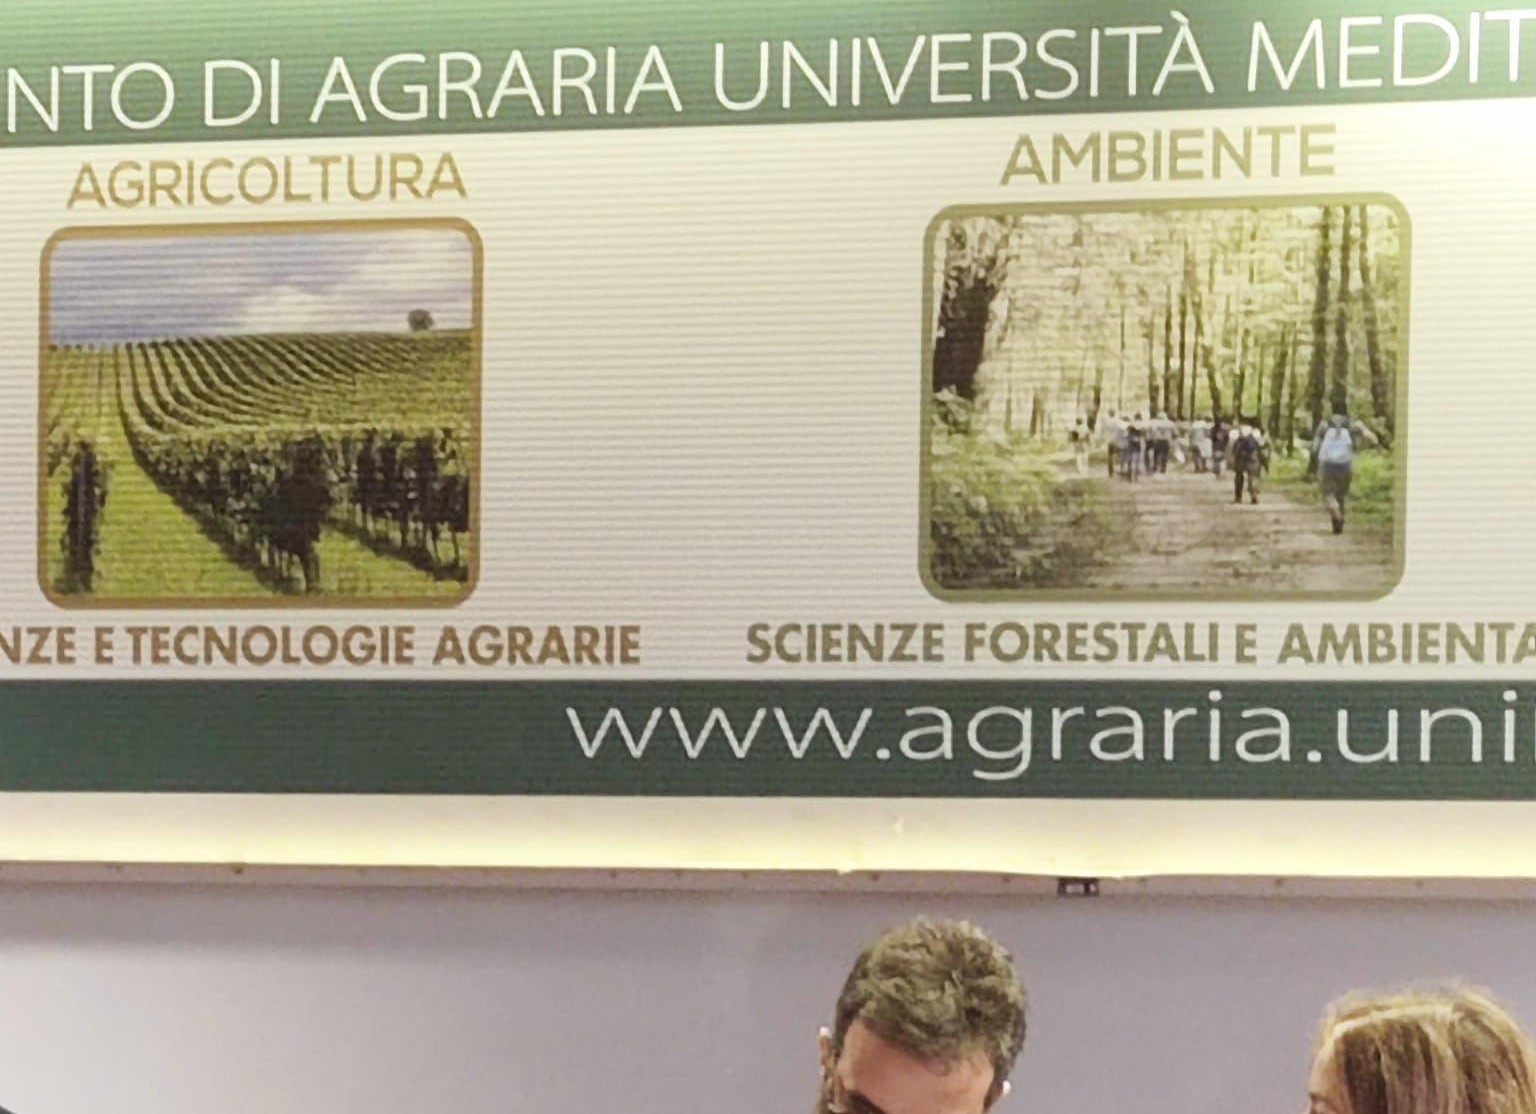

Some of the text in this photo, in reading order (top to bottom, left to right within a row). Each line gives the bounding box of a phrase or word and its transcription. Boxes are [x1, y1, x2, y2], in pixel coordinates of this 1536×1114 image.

[203, 58, 281, 126] DI
[310, 45, 683, 123] AGRARIA
[714, 11, 1215, 112] UNIVERSITÀ
[1247, 9, 1536, 92] MEDIT
[65, 151, 469, 209] AGRICOLTURA
[999, 123, 1337, 187] AMBIENTE
[94, 625, 115, 665] E
[123, 625, 416, 666] TECNOLOGIE
[433, 624, 642, 666] AGRARIE
[745, 622, 1536, 665] SCIENZE FORESTALI E AMBIENTA
[565, 689, 1536, 782] www.agraria.uni
